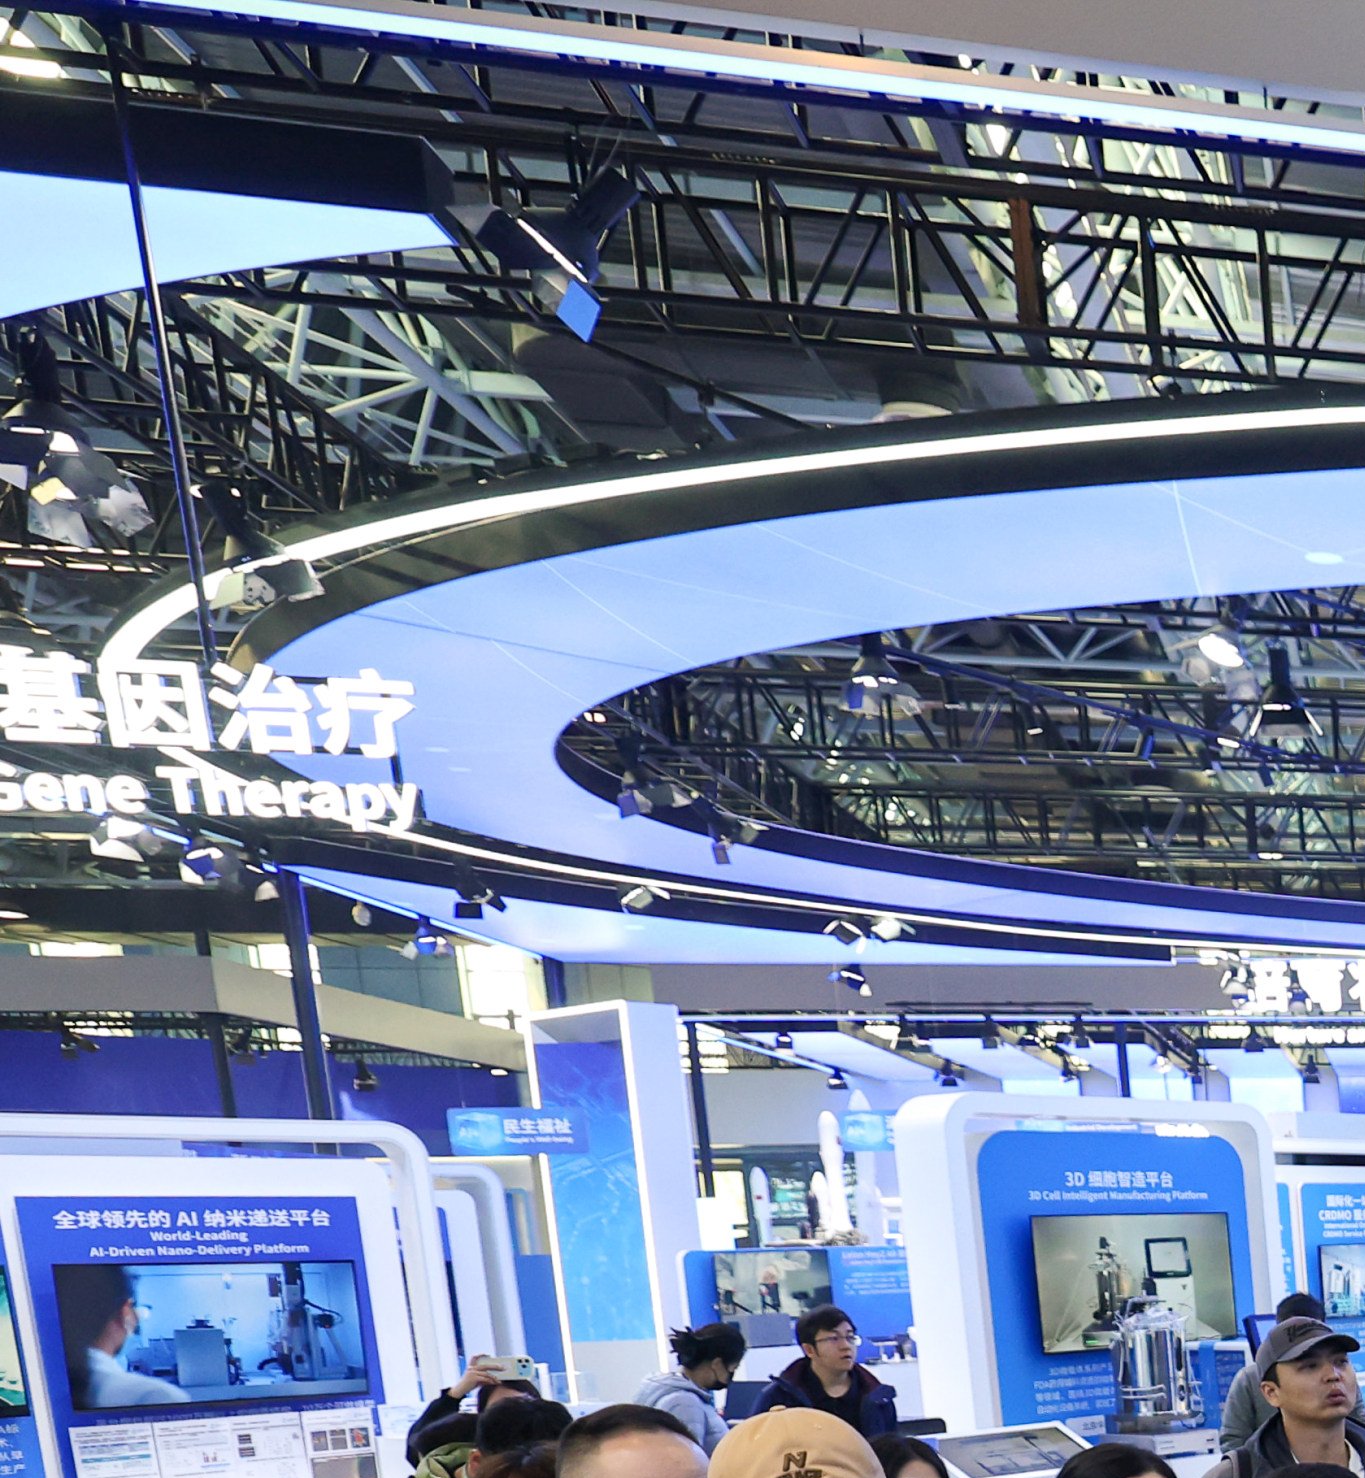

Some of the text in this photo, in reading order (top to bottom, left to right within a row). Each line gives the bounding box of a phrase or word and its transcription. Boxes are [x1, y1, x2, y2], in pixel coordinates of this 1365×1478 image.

[0, 644, 417, 759] 基因治疗
[155, 764, 420, 832] Therapy
[1065, 1171, 1085, 1187] 3D
[52, 1209, 331, 1230] 全球领先的 AI 纳米递送平台
[150, 1230, 249, 1243] World-Leading
[89, 1243, 310, 1258] AI-Driven Nano-Delivery Platform
